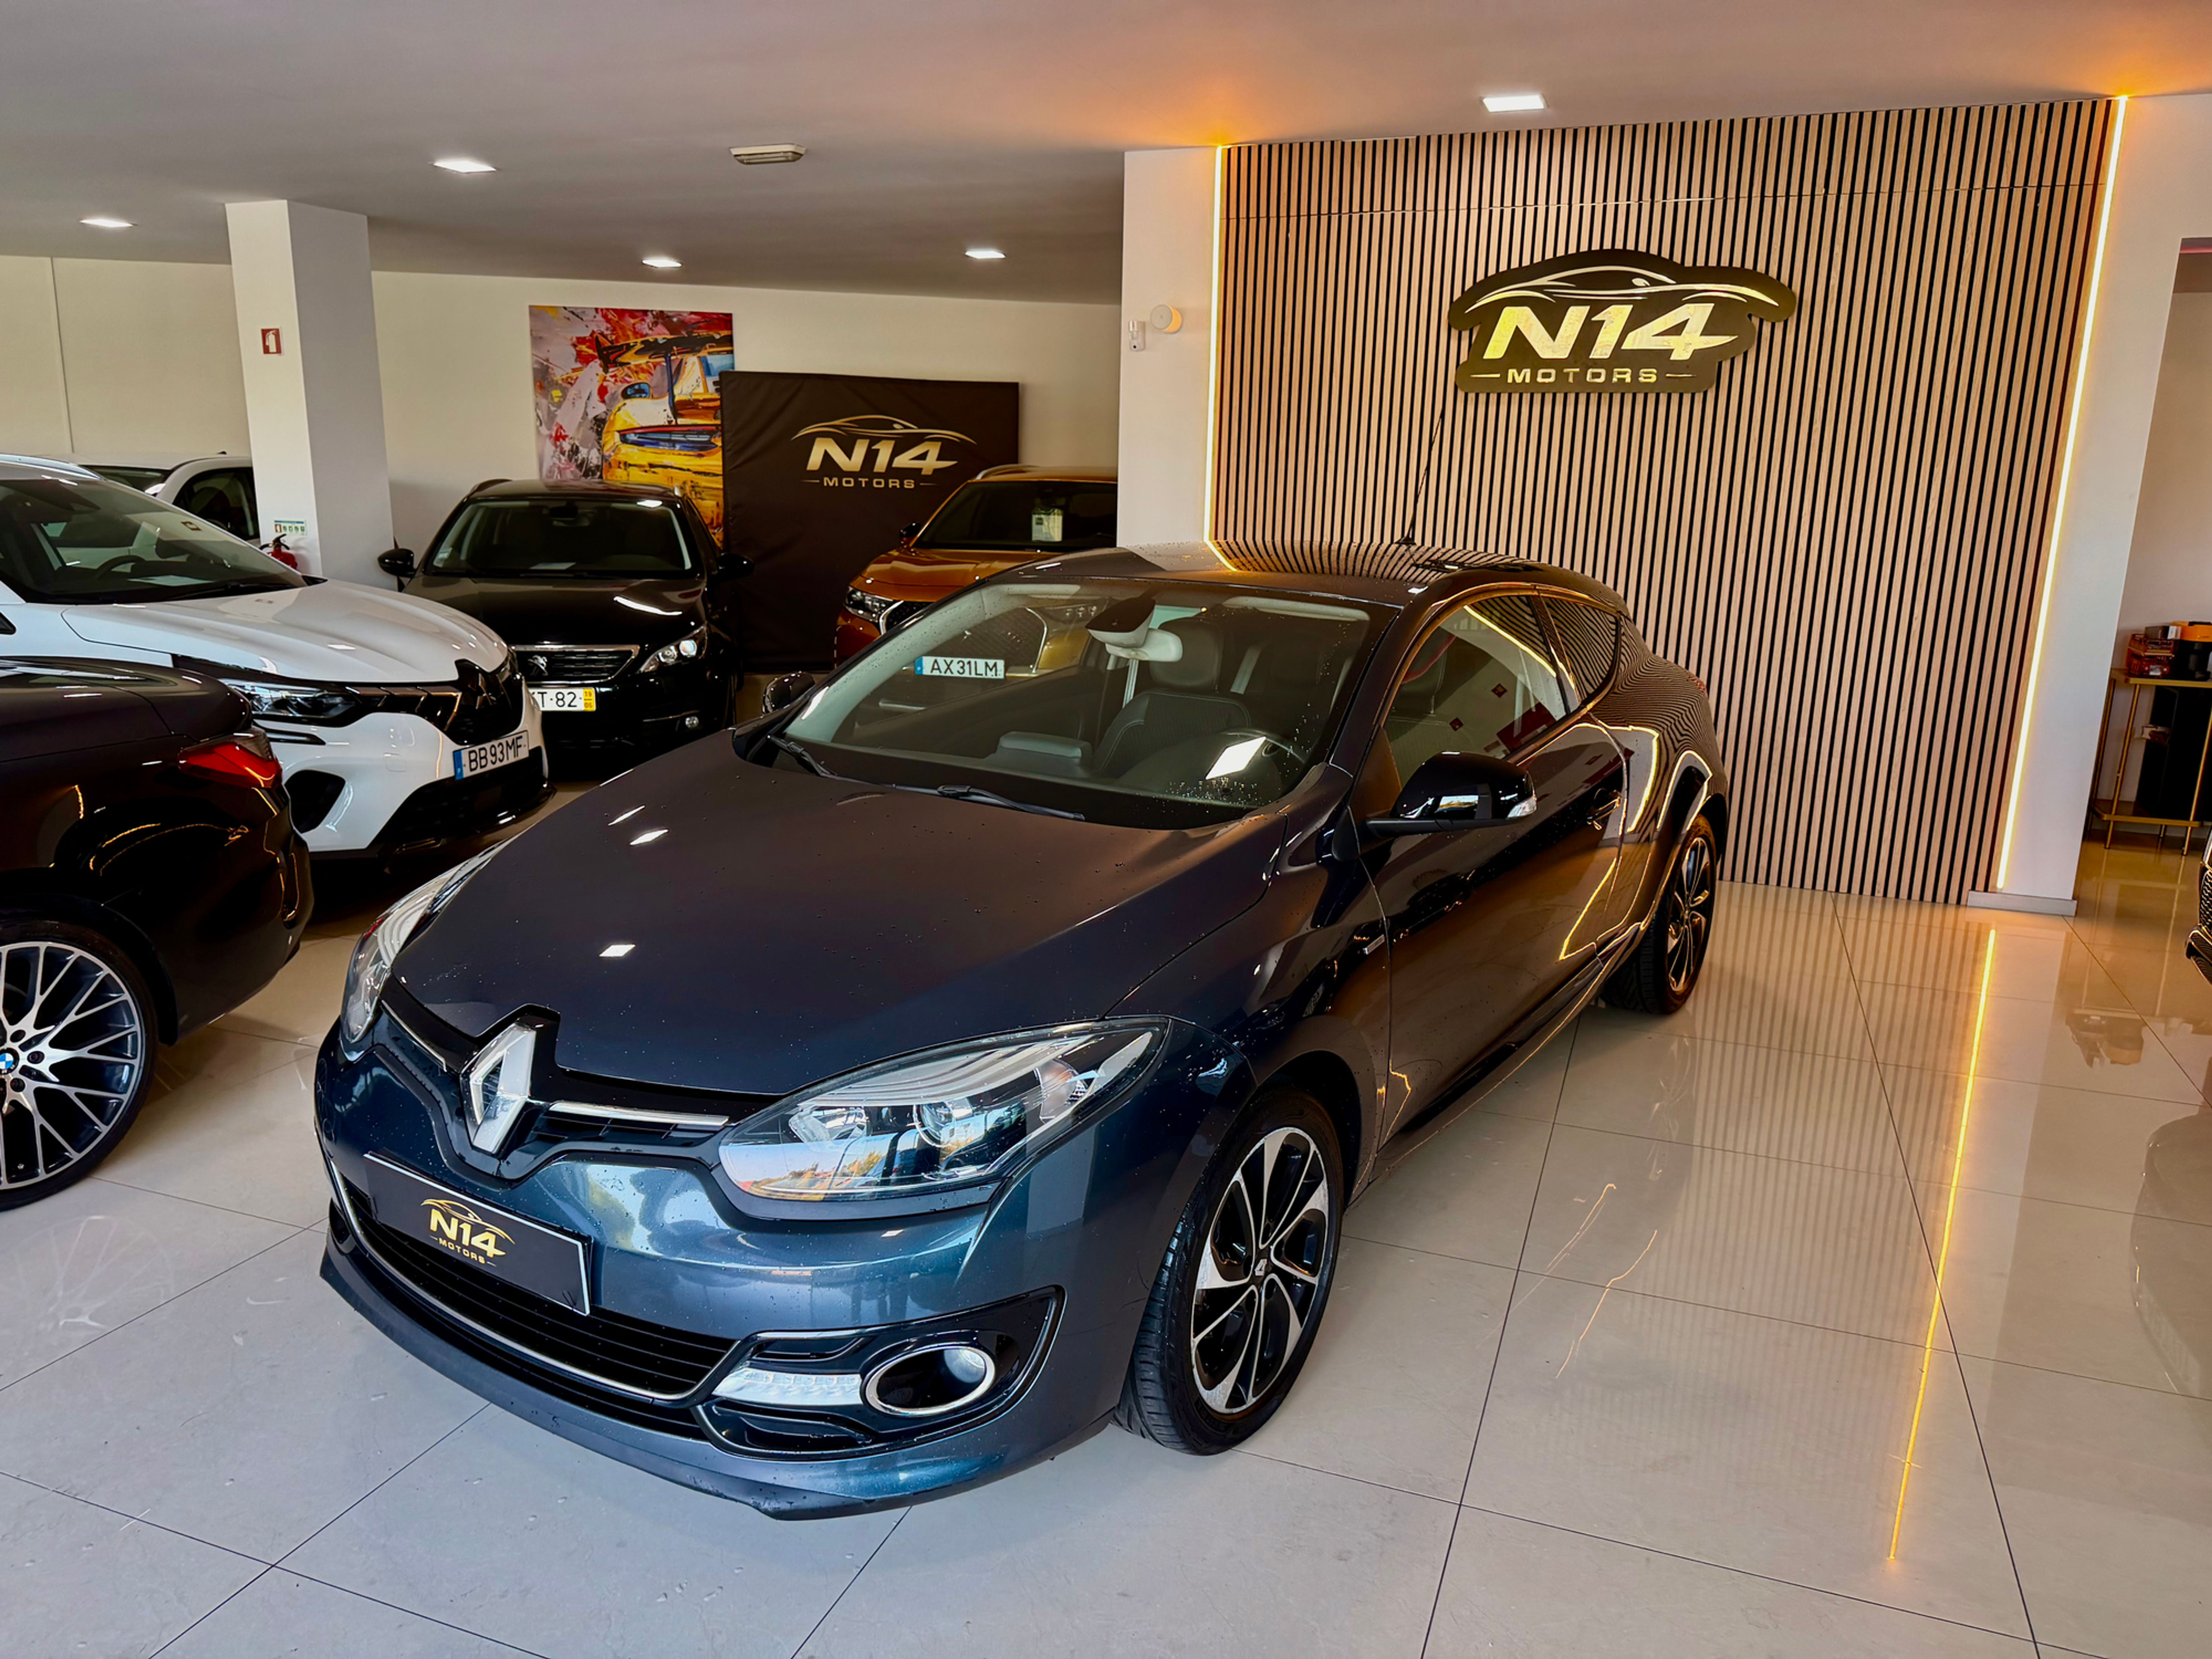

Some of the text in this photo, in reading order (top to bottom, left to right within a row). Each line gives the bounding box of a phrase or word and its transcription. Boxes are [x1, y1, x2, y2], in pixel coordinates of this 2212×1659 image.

[1482, 302, 1739, 361] N14
[1507, 368, 1658, 384] MOTORS
[806, 437, 958, 475] N14
[823, 477, 915, 489] MOTORS
[430, 1208, 506, 1258] N14
[438, 1237, 486, 1264] MOTORS
